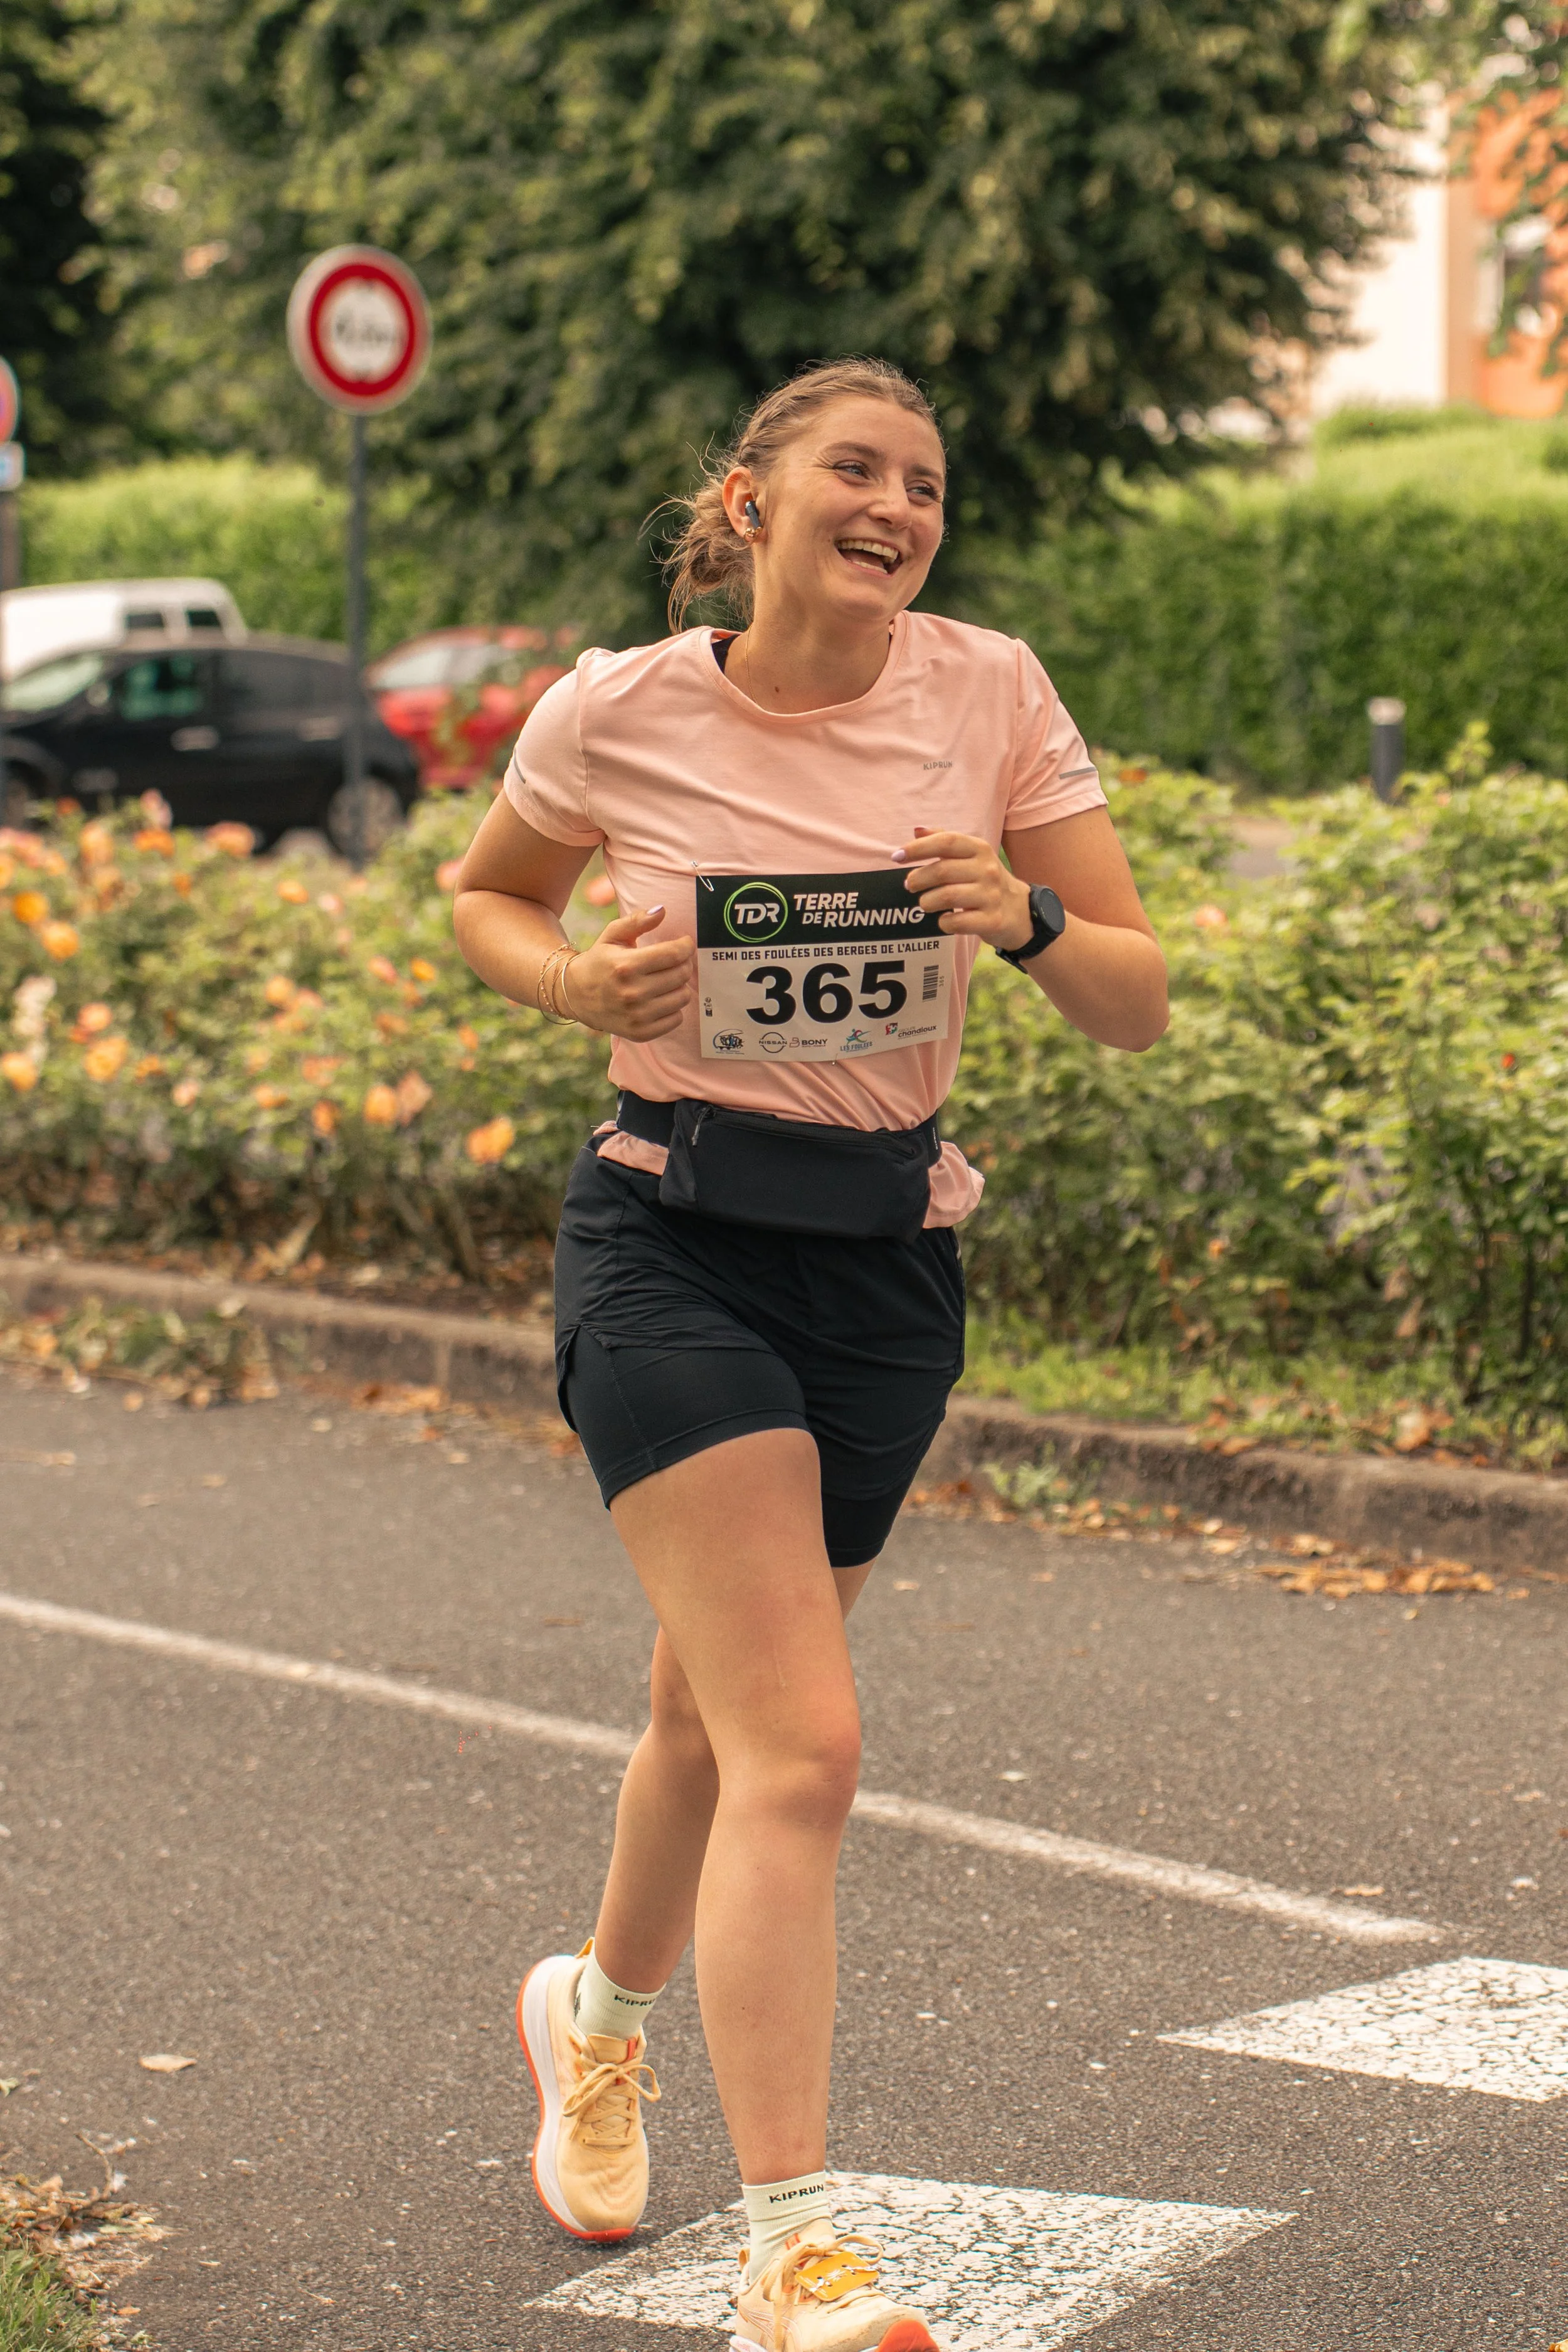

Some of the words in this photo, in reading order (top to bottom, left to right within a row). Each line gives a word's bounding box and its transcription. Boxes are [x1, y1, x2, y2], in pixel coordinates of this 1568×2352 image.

[923, 760, 953, 770] KIPRUN
[793, 892, 859, 910] TERRE
[734, 903, 780, 924] TDR
[802, 911, 823, 925] DE
[823, 906, 926, 928] RUNNING
[712, 951, 738, 961] SEMI
[741, 951, 761, 960] DES
[765, 946, 810, 960] FOULÉES
[813, 947, 834, 957] DES
[837, 945, 877, 956] BERGES
[881, 944, 894, 954] DE
[898, 940, 940, 953] L'ALLIER
[745, 960, 908, 1025] 365
[898, 1025, 937, 1037] chandioux
[614, 1994, 655, 2006] KIPRU
[768, 2184, 825, 2204] KIPRUN
